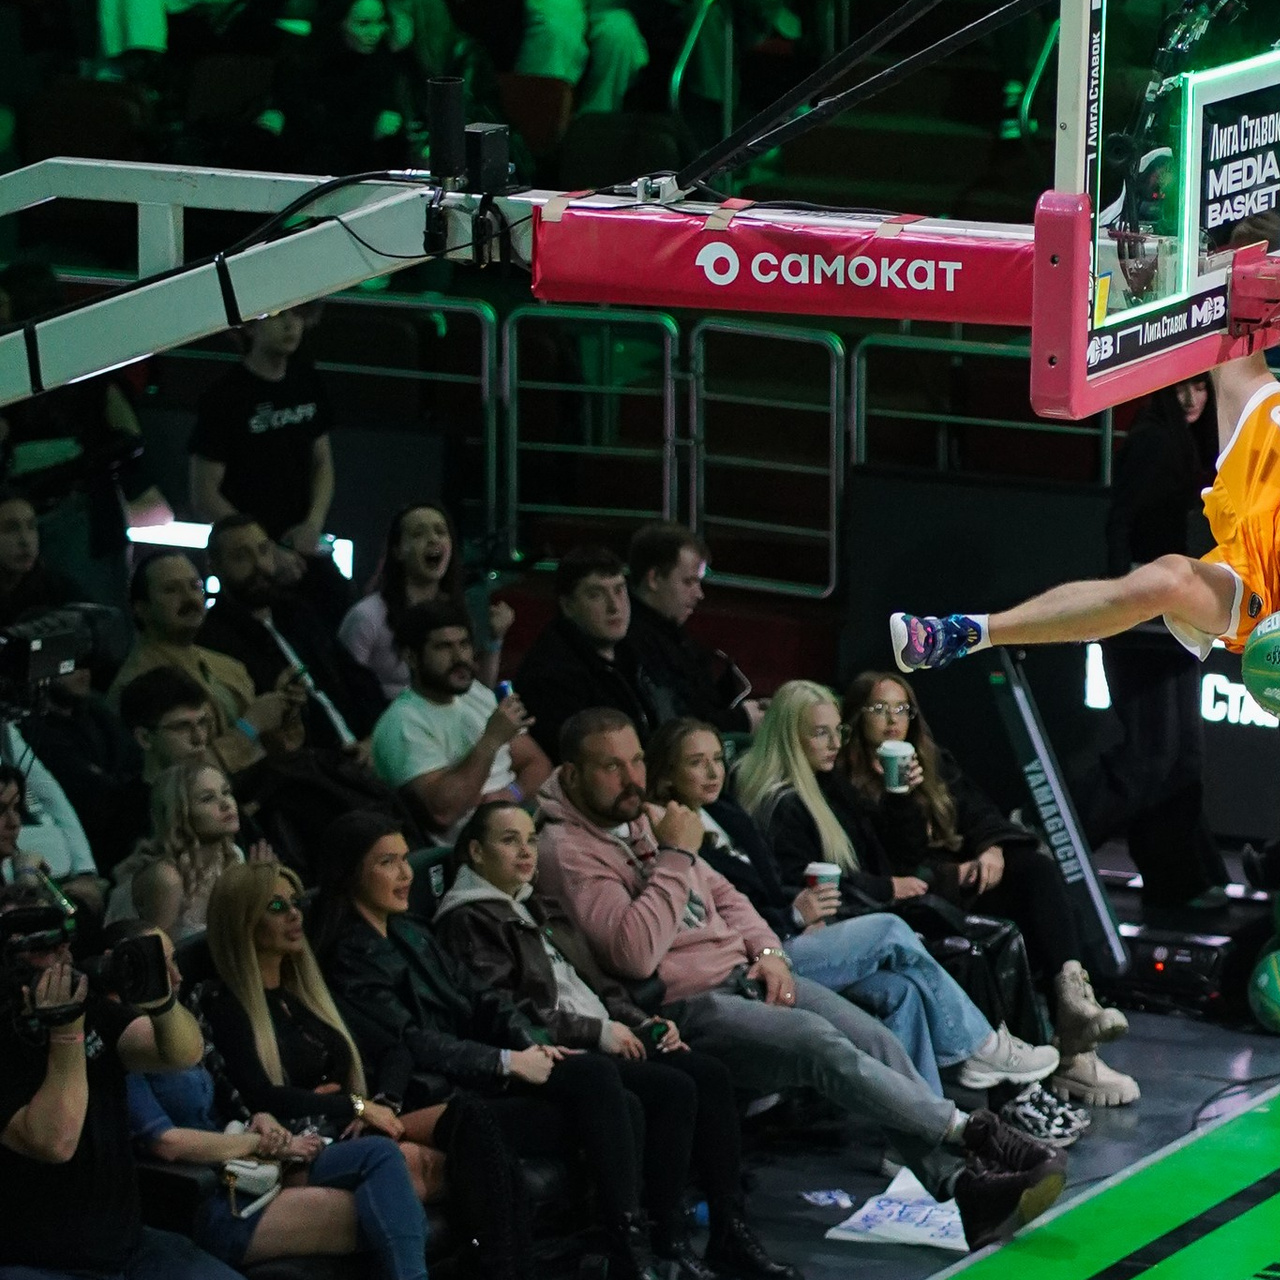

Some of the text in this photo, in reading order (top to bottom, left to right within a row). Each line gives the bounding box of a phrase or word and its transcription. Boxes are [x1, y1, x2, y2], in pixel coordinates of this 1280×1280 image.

[1208, 151, 1280, 200] MEDIA
[1207, 184, 1280, 230] BASKET
[1023, 757, 1085, 885] YAMAGUCHI
